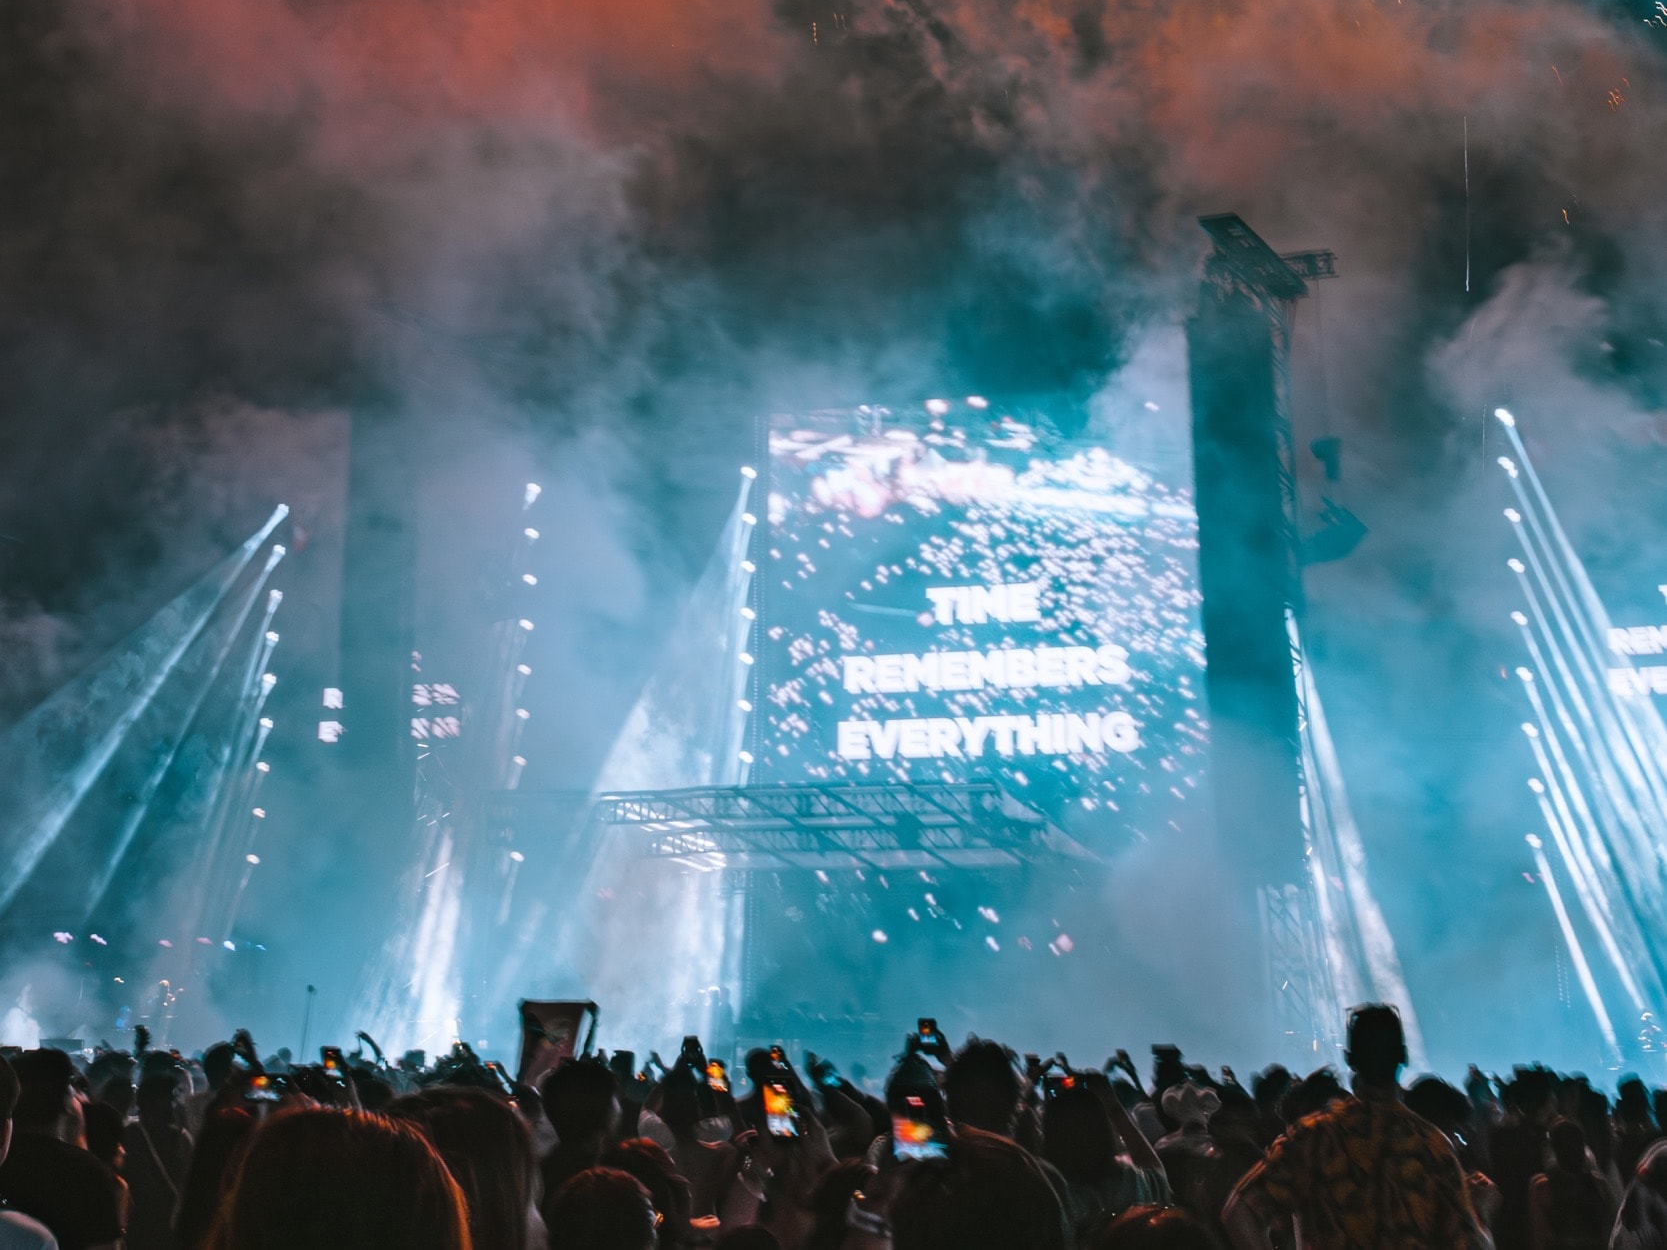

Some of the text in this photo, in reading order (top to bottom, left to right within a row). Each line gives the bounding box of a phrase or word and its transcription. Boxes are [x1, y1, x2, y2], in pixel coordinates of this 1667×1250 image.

[925, 582, 1041, 625] TIME
[842, 644, 1131, 694] REMEMBERS
[838, 711, 1139, 759] EVERYTHING
